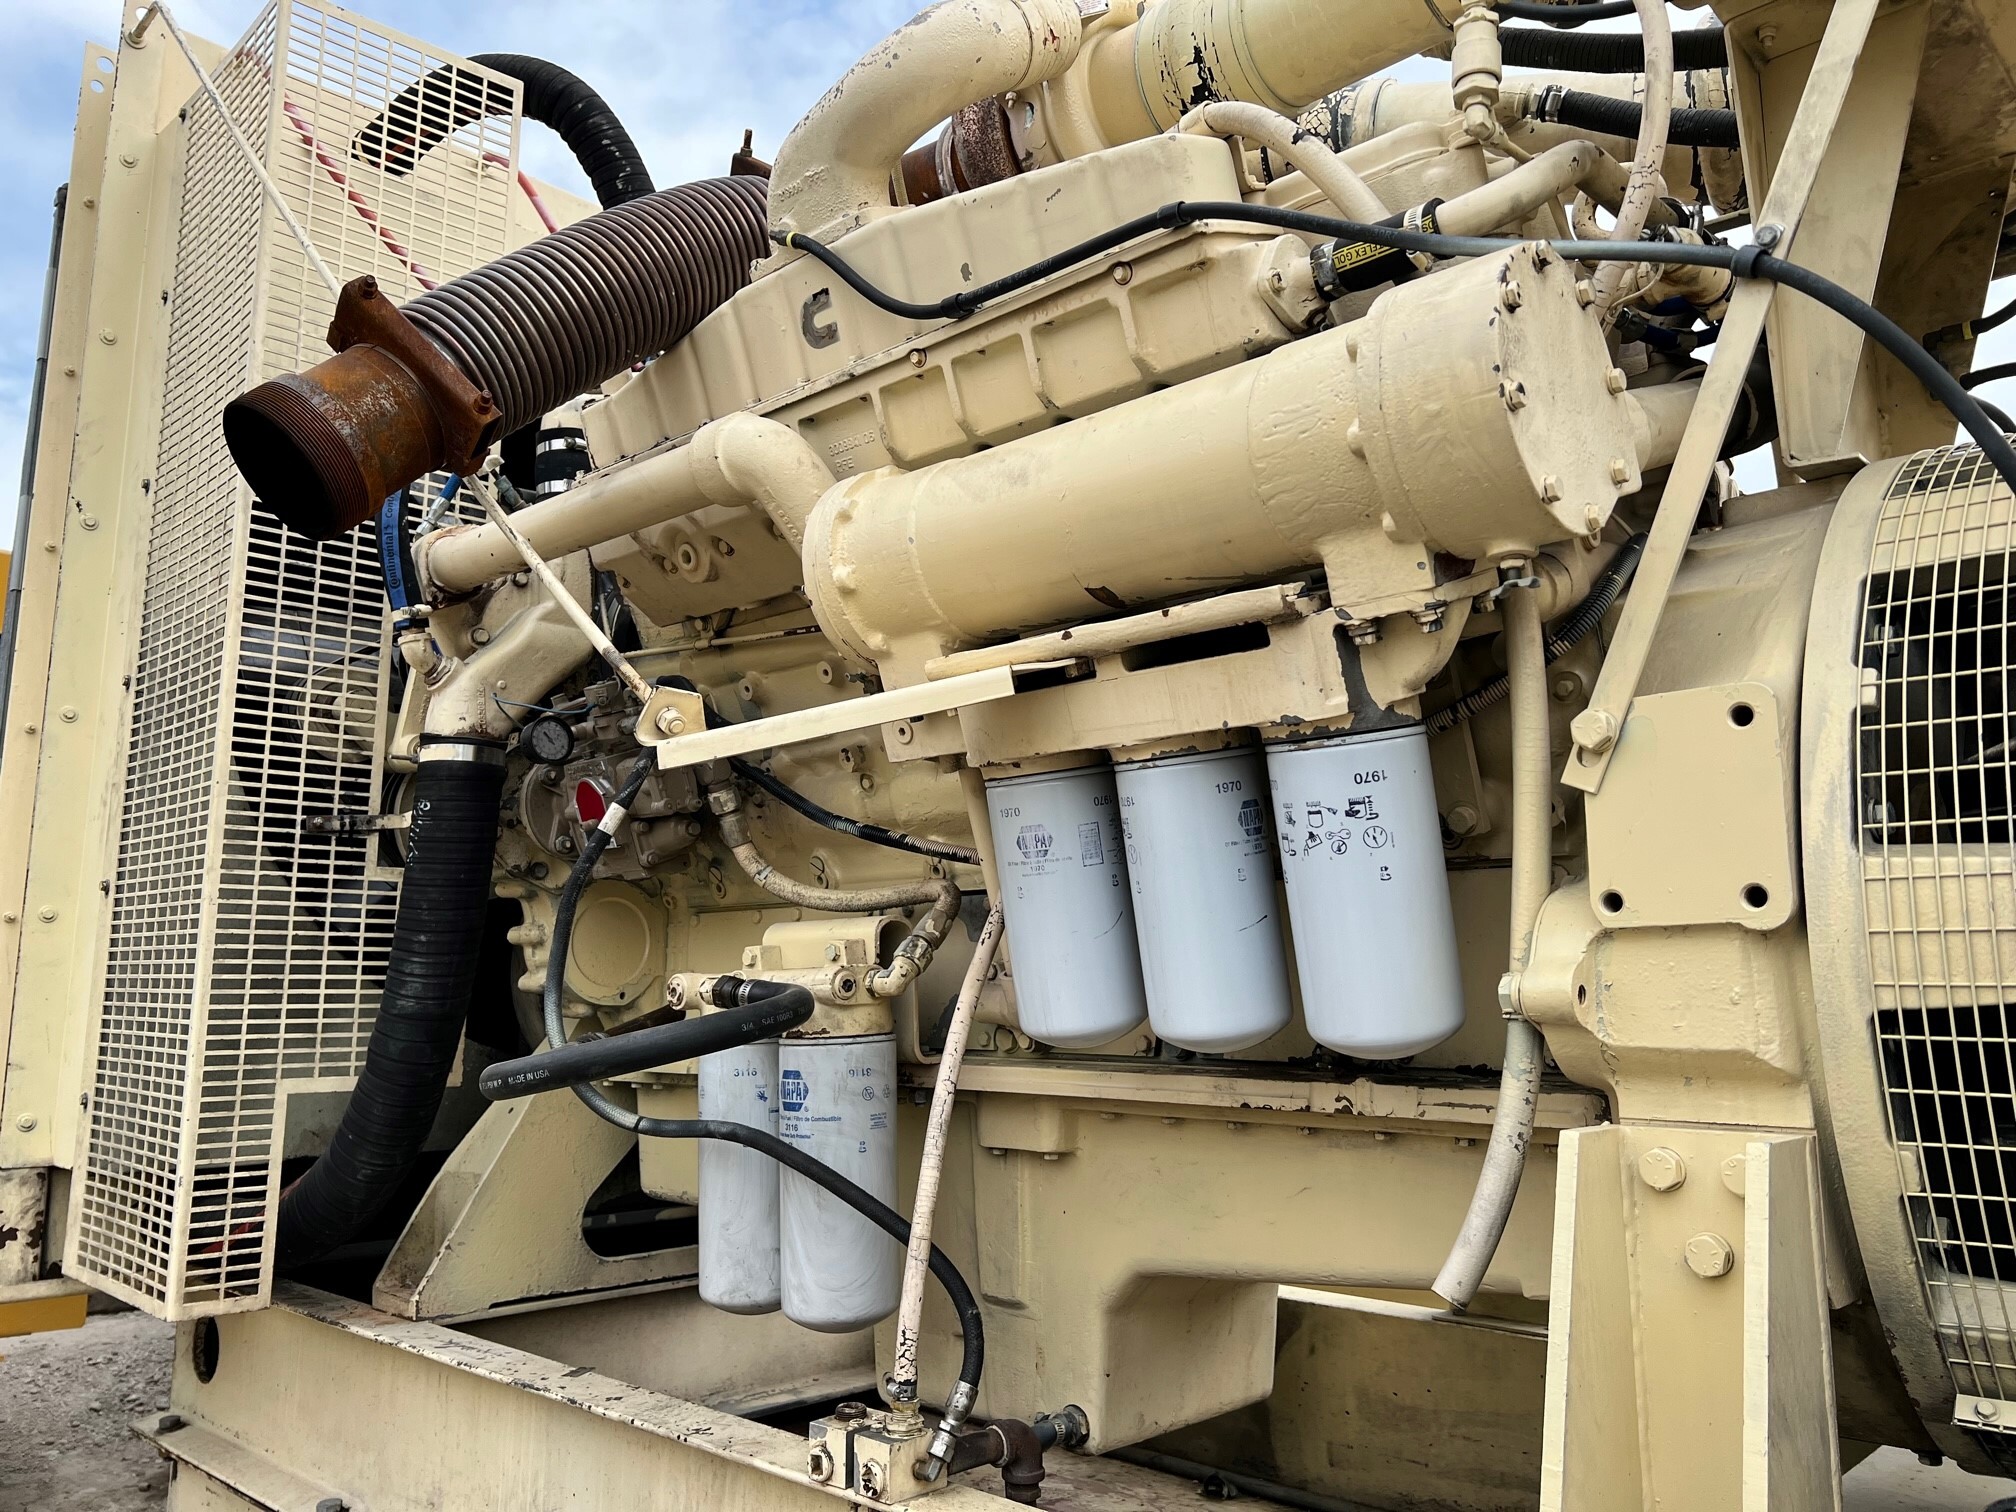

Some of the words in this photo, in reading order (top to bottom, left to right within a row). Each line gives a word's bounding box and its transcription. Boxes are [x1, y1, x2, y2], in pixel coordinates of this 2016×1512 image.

[1334, 250, 1353, 265] GOL
[384, 532, 400, 589] Continental
[1354, 769, 1388, 785] 1970
[1215, 780, 1242, 794] 1970
[1093, 795, 1112, 807] 1970
[1000, 807, 1020, 818] 1970
[741, 1022, 754, 1031] 3/4
[762, 1016, 775, 1026] SAE
[508, 1074, 525, 1085] MADE
[526, 1072, 533, 1081] IN
[534, 1069, 550, 1079] USA
[733, 1067, 757, 1077] 3116
[785, 1123, 798, 1131] 3116
